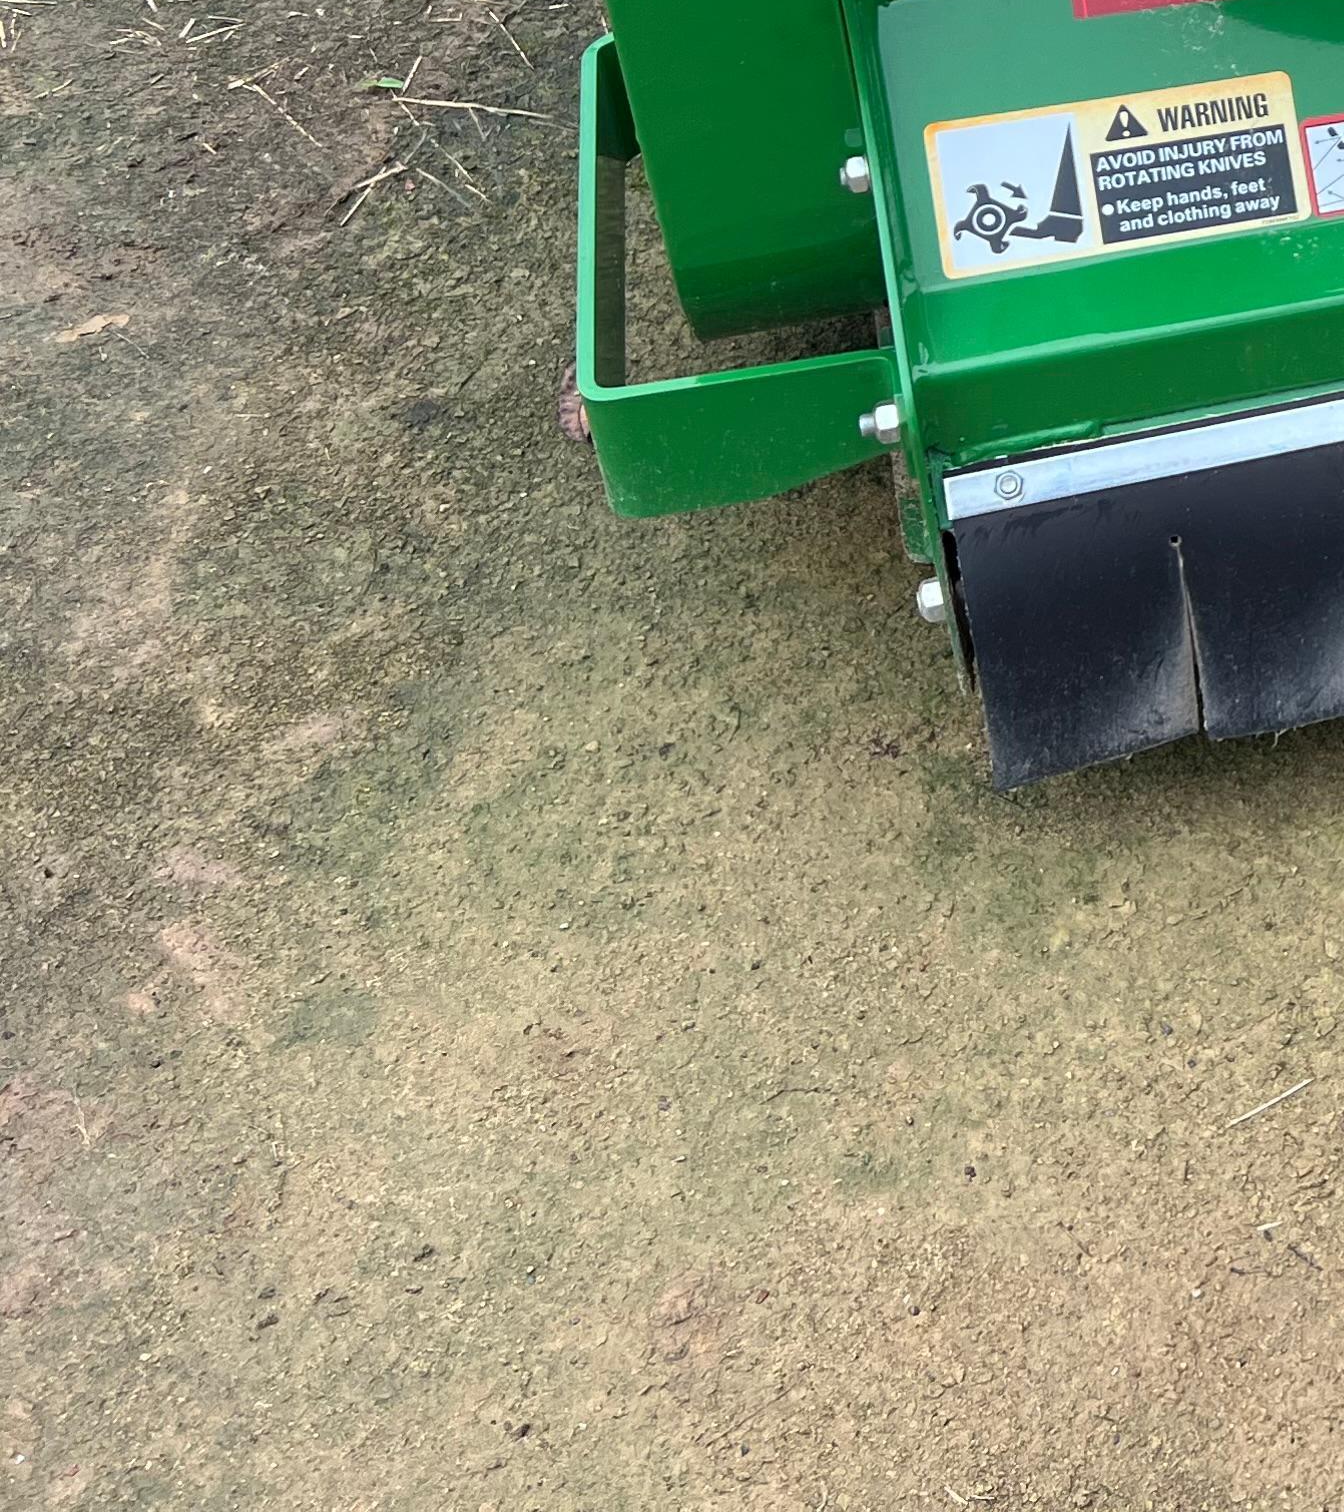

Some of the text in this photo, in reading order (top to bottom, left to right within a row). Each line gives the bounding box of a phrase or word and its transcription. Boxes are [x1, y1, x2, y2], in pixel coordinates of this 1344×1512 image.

[1157, 93, 1269, 132] WARNING
[1096, 129, 1284, 173] AVOID INJURY FROM
[1098, 151, 1267, 190] ROTATING KNIVES
[1116, 177, 1266, 214] Keep hands, feet
[1119, 195, 1280, 232] and clothing away
